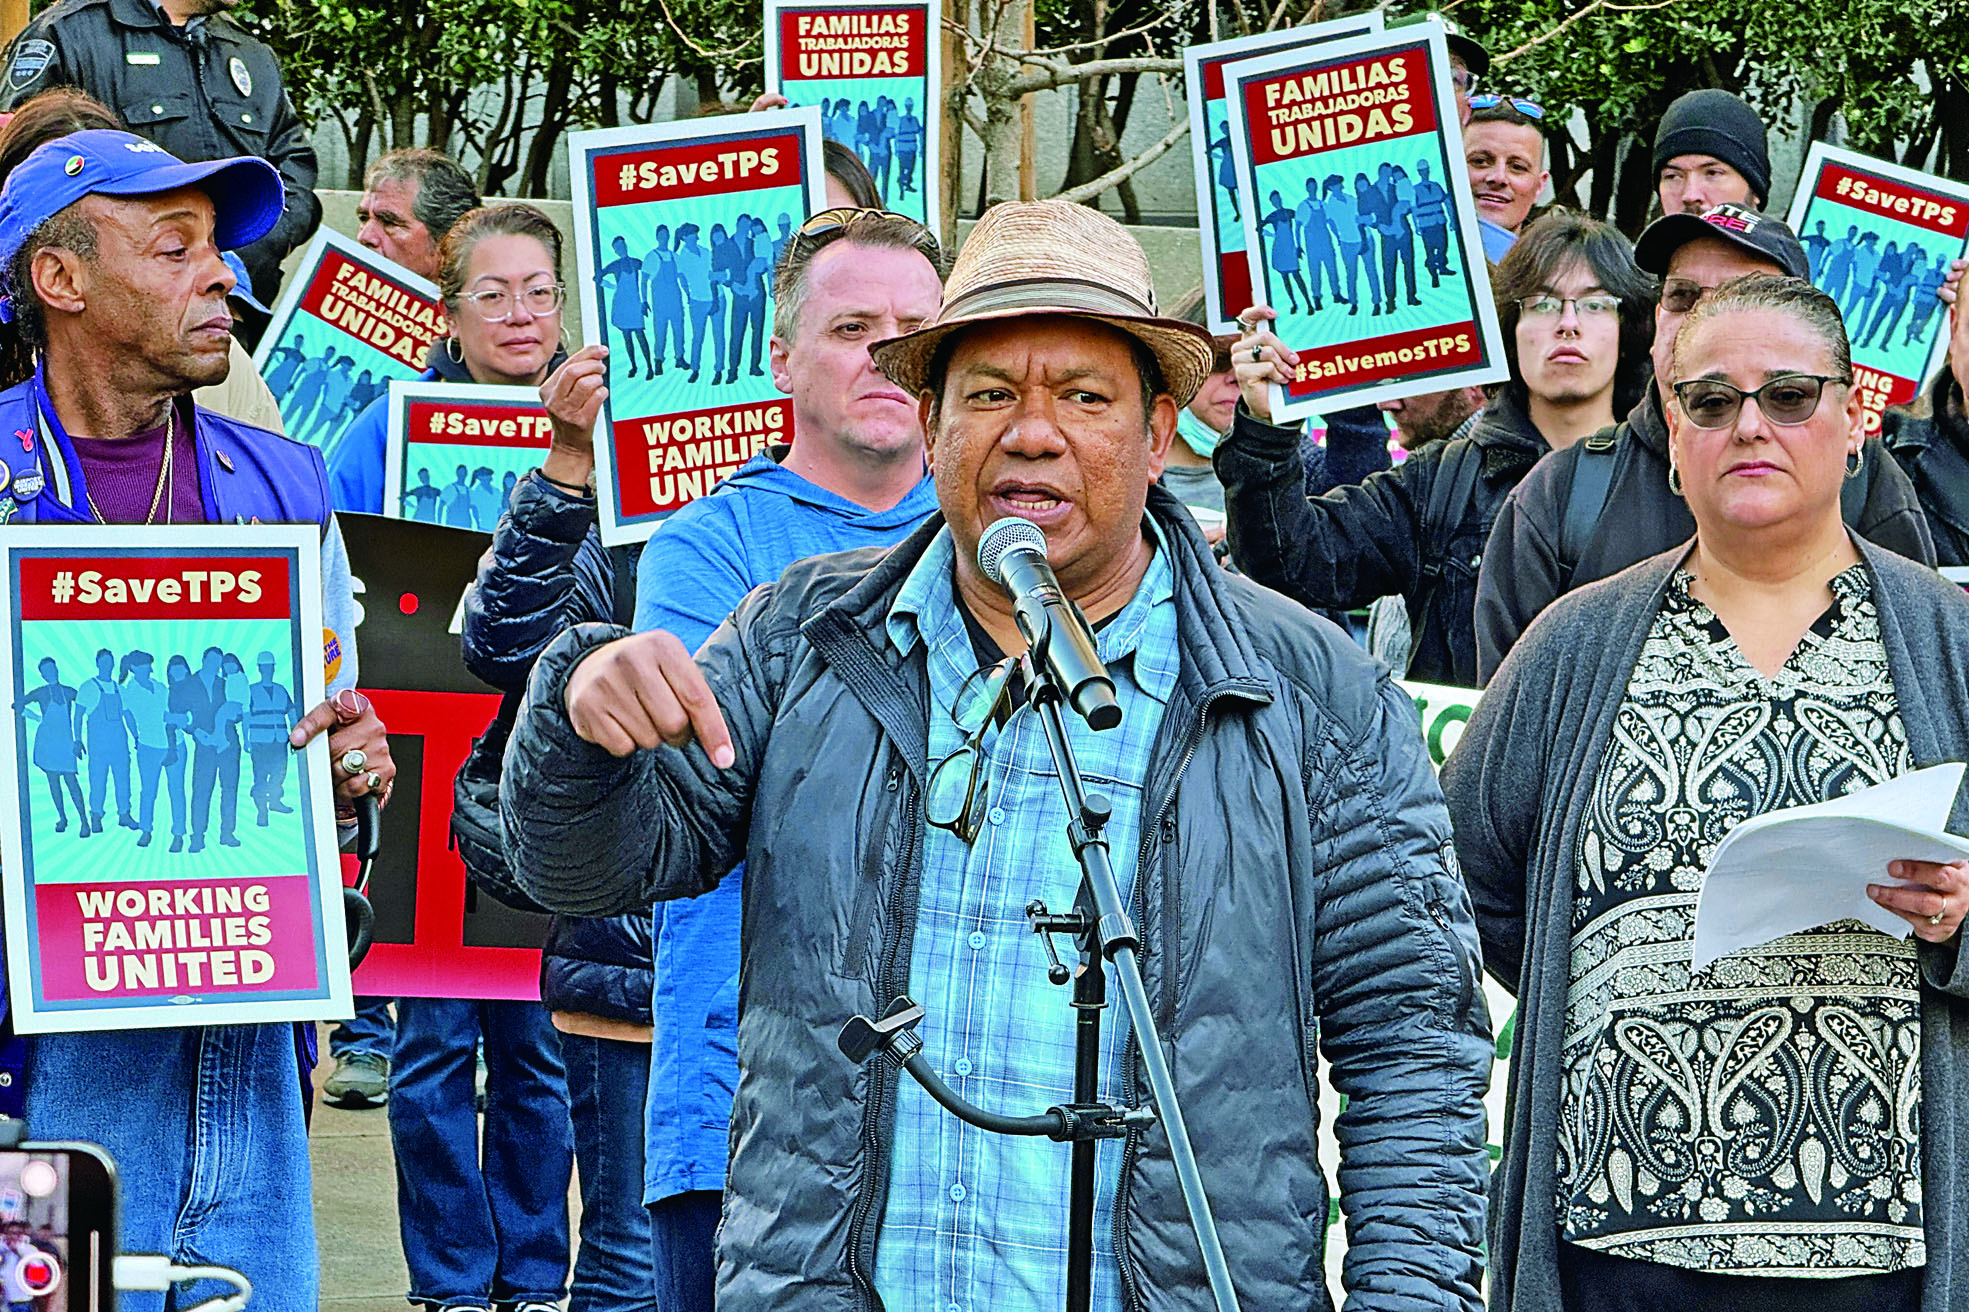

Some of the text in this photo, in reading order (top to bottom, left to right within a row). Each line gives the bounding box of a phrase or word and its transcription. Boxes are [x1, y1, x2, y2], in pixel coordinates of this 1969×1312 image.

[798, 14, 909, 35] FAMILIAS
[798, 36, 909, 50] TRABAJADORAS
[799, 51, 909, 76] UNIDAS
[1265, 58, 1407, 107] FAMILIAS
[1268, 84, 1409, 125] TRABAJADORAS
[1271, 103, 1413, 156] UNIDAS
[619, 148, 779, 191] #SaveTPS
[1836, 177, 1956, 225] #SaveTPS
[330, 280, 438, 347] TRABAJADORA
[336, 262, 448, 334] FAMILIAS
[320, 294, 430, 368] UNIDAS
[1295, 334, 1471, 382] #SalvemosTPS
[429, 412, 553, 438] #SaveTP
[642, 406, 783, 445] WORKING
[650, 464, 744, 505] UNIT
[51, 570, 262, 604] #SaveTPS
[324, 645, 341, 667] URE
[76, 885, 270, 918] WORKING
[83, 915, 272, 952] FAMILIES
[84, 950, 275, 992] UNITED
